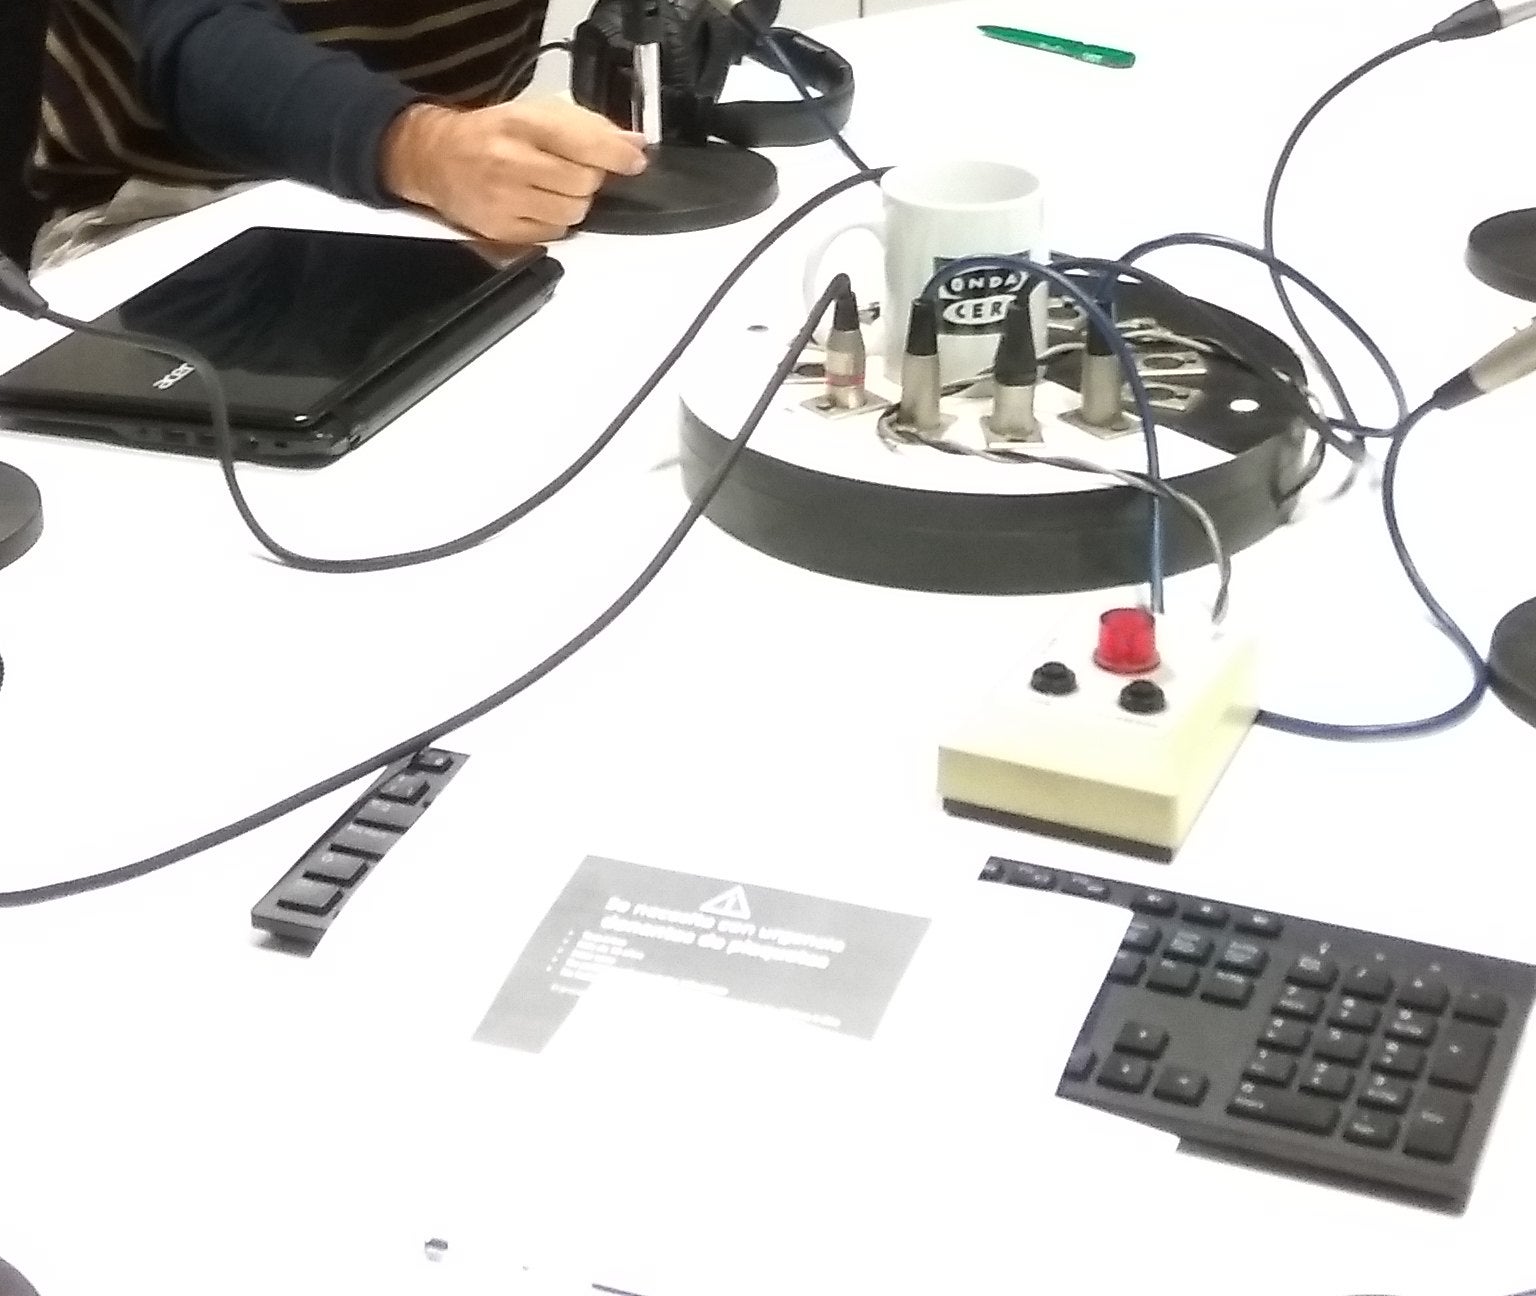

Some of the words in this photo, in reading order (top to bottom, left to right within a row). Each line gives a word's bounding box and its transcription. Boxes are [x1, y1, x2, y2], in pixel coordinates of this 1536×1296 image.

[950, 274, 1018, 292] ONDA
[955, 302, 1002, 318] CER
[153, 363, 195, 389] acer
